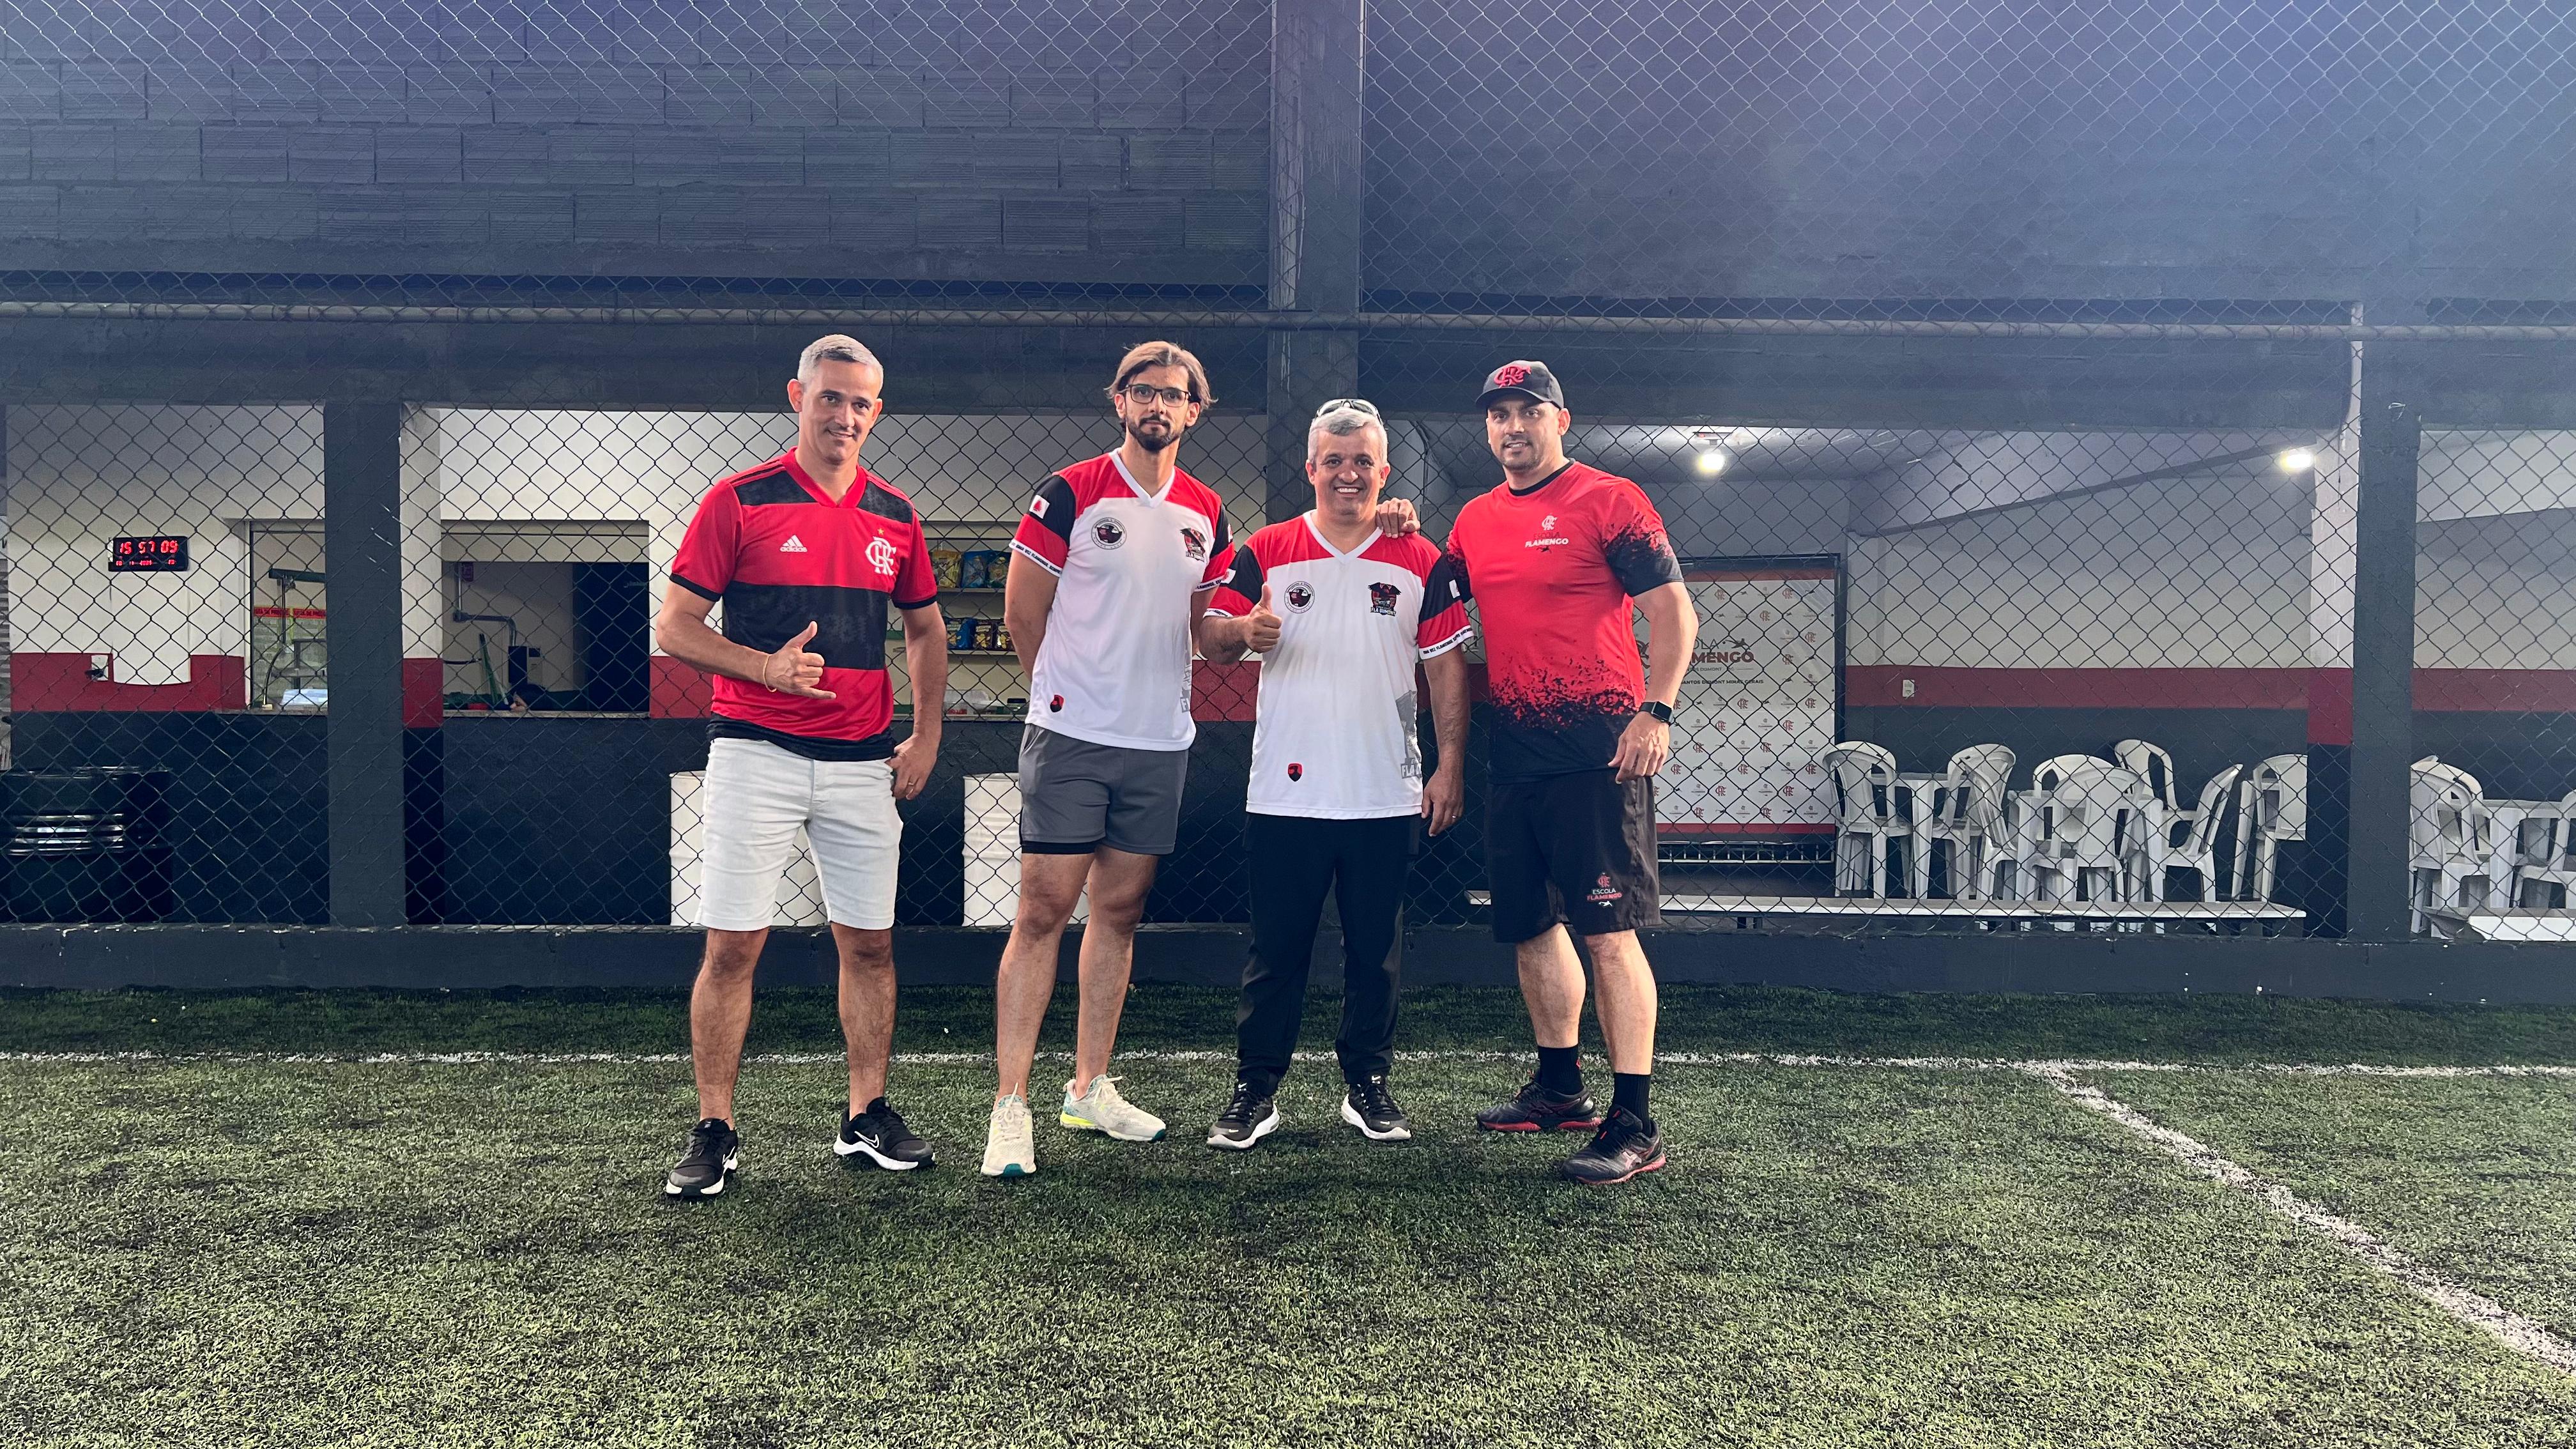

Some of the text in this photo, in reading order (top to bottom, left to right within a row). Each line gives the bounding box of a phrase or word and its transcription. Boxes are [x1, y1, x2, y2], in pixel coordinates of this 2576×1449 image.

[119, 541, 132, 555] 15
[160, 540, 178, 553] 09
[1524, 537, 1569, 548] FLAMENGO
[1693, 639, 1719, 649] OLA
[1690, 651, 1754, 663] MENGO
